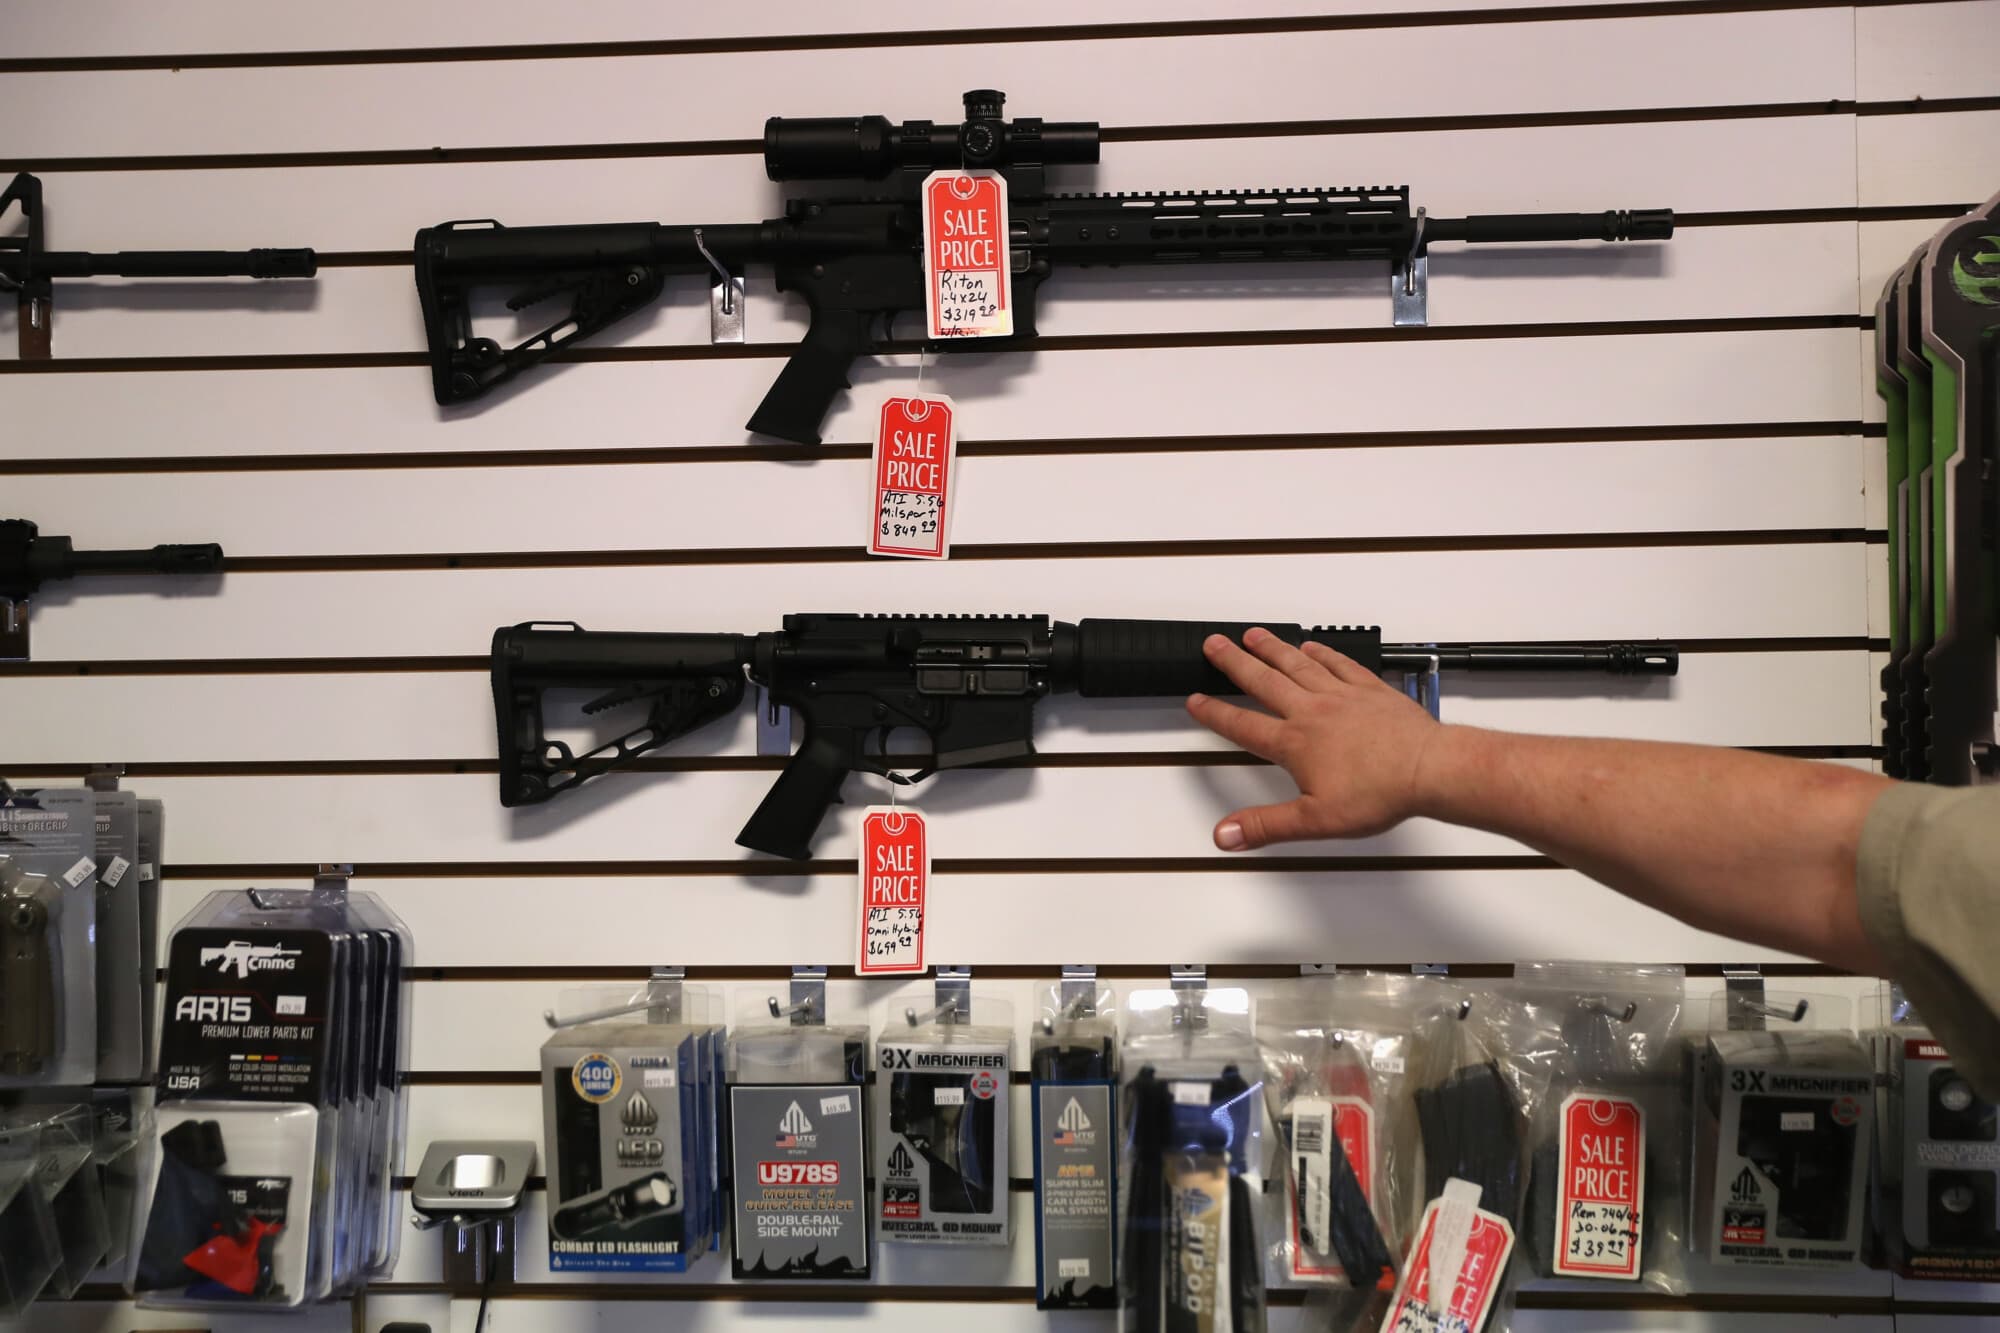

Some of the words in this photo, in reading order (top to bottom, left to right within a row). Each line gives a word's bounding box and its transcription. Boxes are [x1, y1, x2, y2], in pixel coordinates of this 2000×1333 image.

[943, 209, 988, 236] SALE
[941, 240, 994, 267] PRICE
[942, 269, 983, 290] Riton
[893, 430, 937, 459] SALE
[886, 460, 939, 489] PRICE
[883, 490, 909, 505] ATI
[915, 494, 945, 507] 5.56
[880, 506, 937, 520] Milsport
[877, 845, 914, 872] SALE
[872, 876, 918, 903] PRICE
[869, 907, 891, 921] ATI
[898, 908, 922, 919] 5.56
[867, 927, 889, 936] Omni
[892, 920, 922, 937] Hybrid
[175, 996, 252, 1022] AR15
[202, 1025, 240, 1038] PREMIUM
[242, 1026, 270, 1039] LOWER
[272, 1026, 299, 1039] PARTS
[301, 1027, 315, 1039] KIT
[881, 1048, 912, 1069] 3X
[917, 1053, 1004, 1067] MAGNIFIER
[278, 1064, 312, 1073] INSTALLATION
[581, 1067, 613, 1080] 400
[167, 1076, 200, 1089] USA
[582, 1081, 612, 1090] LUMENS
[1731, 1070, 1766, 1093] 3X
[1771, 1077, 1869, 1092] MAGNIFIER
[617, 1140, 664, 1160] LED
[1580, 1134, 1625, 1165] SALE
[760, 1164, 838, 1183] U978S
[889, 1169, 912, 1177] UTG
[1046, 1179, 1079, 1188] SUPER
[1081, 1179, 1104, 1187] SLIM
[1574, 1167, 1629, 1199] PRICE
[762, 1189, 813, 1200] MODEL
[817, 1188, 836, 1199] 47
[1047, 1197, 1067, 1206] CAR
[1069, 1197, 1106, 1206] LENGTH
[745, 1200, 790, 1212] QUICK
[792, 1200, 854, 1211] RELEASE
[1045, 1206, 1067, 1215] RAIL
[1069, 1206, 1108, 1216] SYSTEM
[1572, 1200, 1596, 1218] Rem
[757, 1215, 843, 1226] DOUBLE-RAIL
[881, 1221, 938, 1233] INTEGRAL
[961, 1222, 1003, 1234] MOUNT
[757, 1226, 788, 1237] SIDE
[791, 1226, 840, 1237] MOUNT
[552, 1241, 595, 1253] COMBAT
[597, 1242, 615, 1253] LED
[617, 1241, 679, 1254] FLASHLIGHT
[1187, 1220, 1205, 1313] BIPOD
